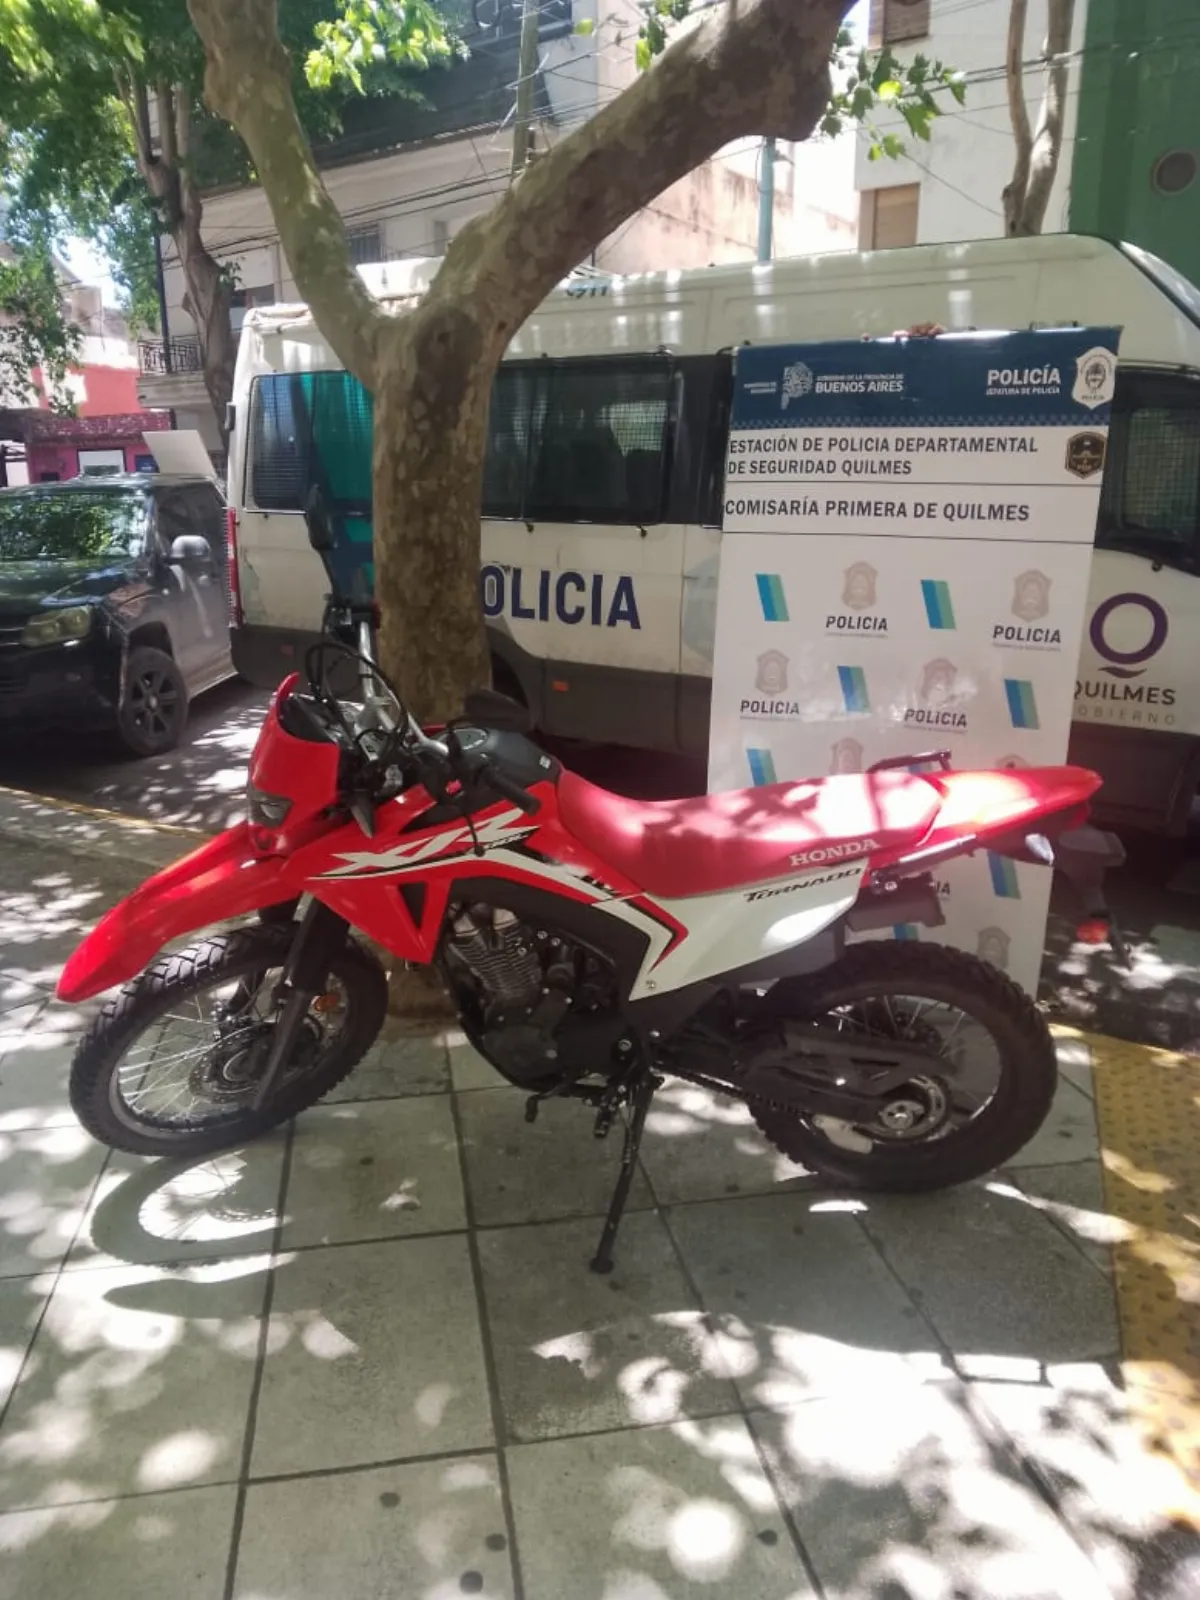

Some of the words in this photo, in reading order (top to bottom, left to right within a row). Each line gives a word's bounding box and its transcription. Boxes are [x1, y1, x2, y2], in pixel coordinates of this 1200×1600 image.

[986, 363, 1061, 386] POLICÍA
[815, 381, 865, 394] BUENOS
[867, 380, 904, 393] AIRES
[730, 434, 798, 454] ESTACIÓN
[803, 437, 824, 452] DE
[828, 437, 890, 452] POLICIA
[895, 437, 1038, 453] DEPARTAMENTAL
[728, 460, 747, 474] DE
[750, 460, 837, 475] SEGURIDAD
[841, 459, 912, 477] QUILMES
[725, 495, 820, 517] COMISARÍA
[825, 500, 908, 518] PRIMERA
[913, 502, 938, 519] DE
[943, 503, 1030, 522] QUILMES
[480, 564, 642, 630] OLICIA
[825, 615, 888, 631] POLICIA
[993, 625, 1062, 643] POLICIA
[740, 699, 800, 715] POLICIA
[1077, 705, 1176, 726] OBIERNO
[904, 708, 968, 728] POLICIA
[789, 838, 880, 867] HONDA
